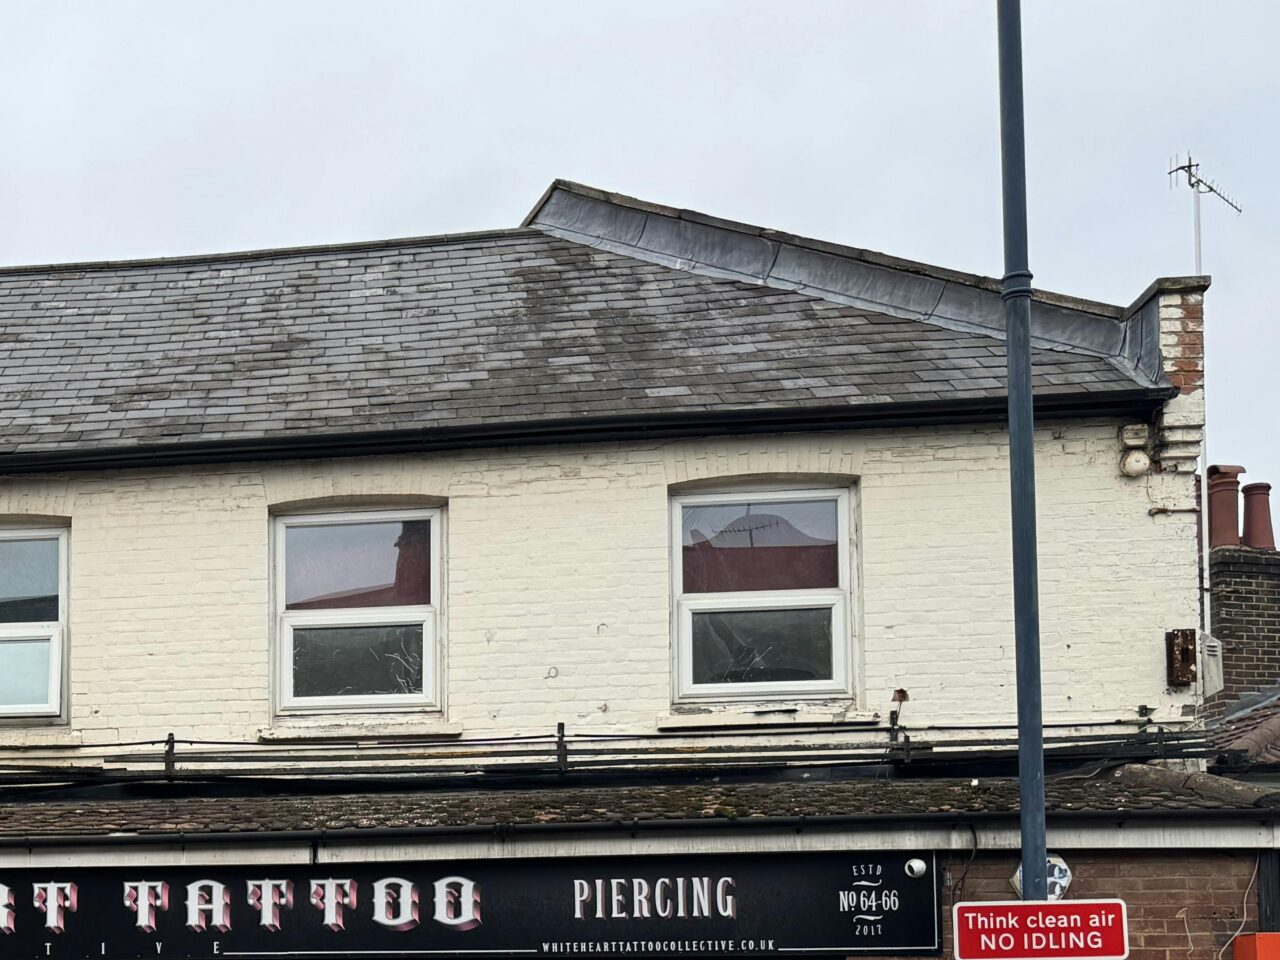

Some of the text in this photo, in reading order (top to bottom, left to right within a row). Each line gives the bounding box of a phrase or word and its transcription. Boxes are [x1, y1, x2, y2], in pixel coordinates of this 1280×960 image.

[852, 864, 882, 876] ESTD
[123, 876, 483, 934] TATTOO
[572, 876, 736, 919] PIERCING
[860, 889, 899, 911] 64-66
[964, 910, 1116, 929] Think clean air
[542, 940, 775, 953] WHITEHEARTTATTOOCOLLECTIVE.CO.UK
[980, 931, 1103, 950] NO IDLING
